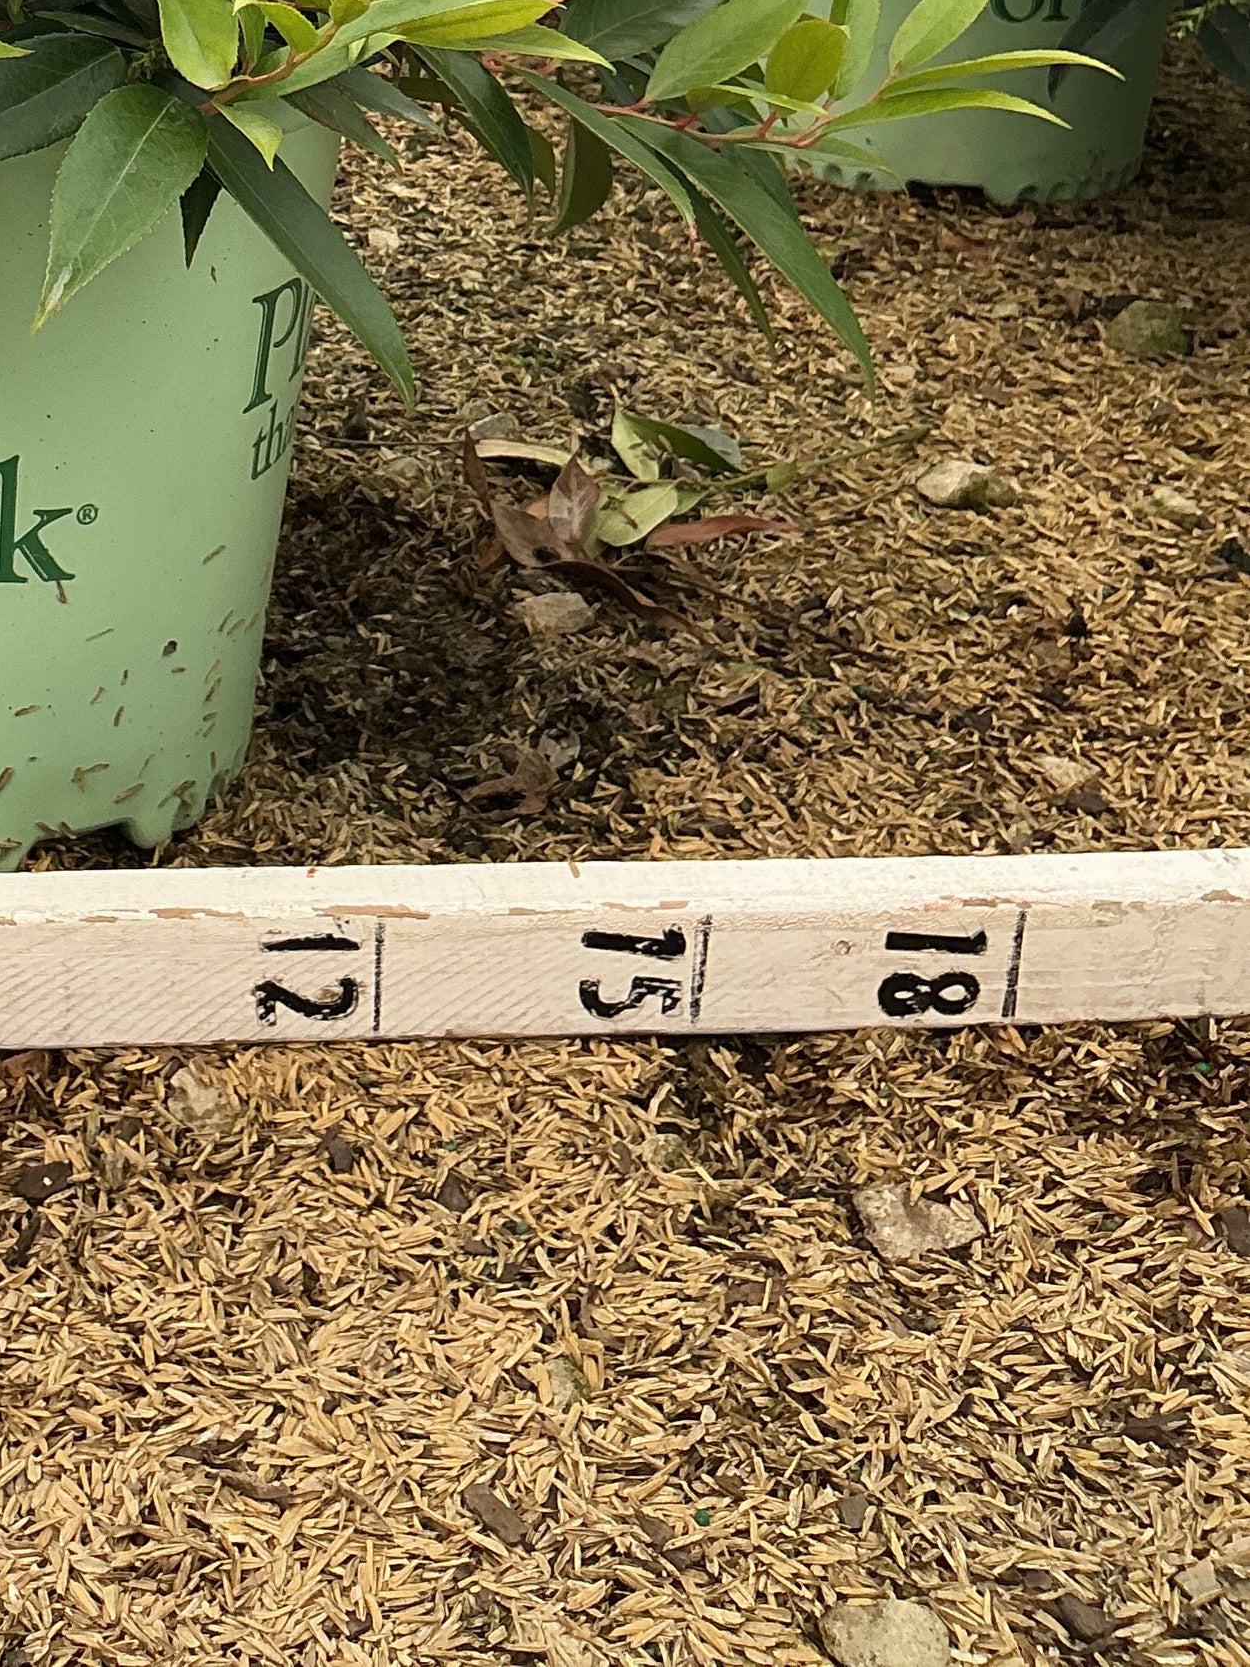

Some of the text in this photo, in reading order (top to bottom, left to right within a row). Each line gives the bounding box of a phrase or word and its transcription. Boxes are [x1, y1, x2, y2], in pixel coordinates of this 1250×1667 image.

[255, 932, 362, 1027] 12
[578, 925, 687, 1019] 15
[877, 927, 990, 1018] 18
